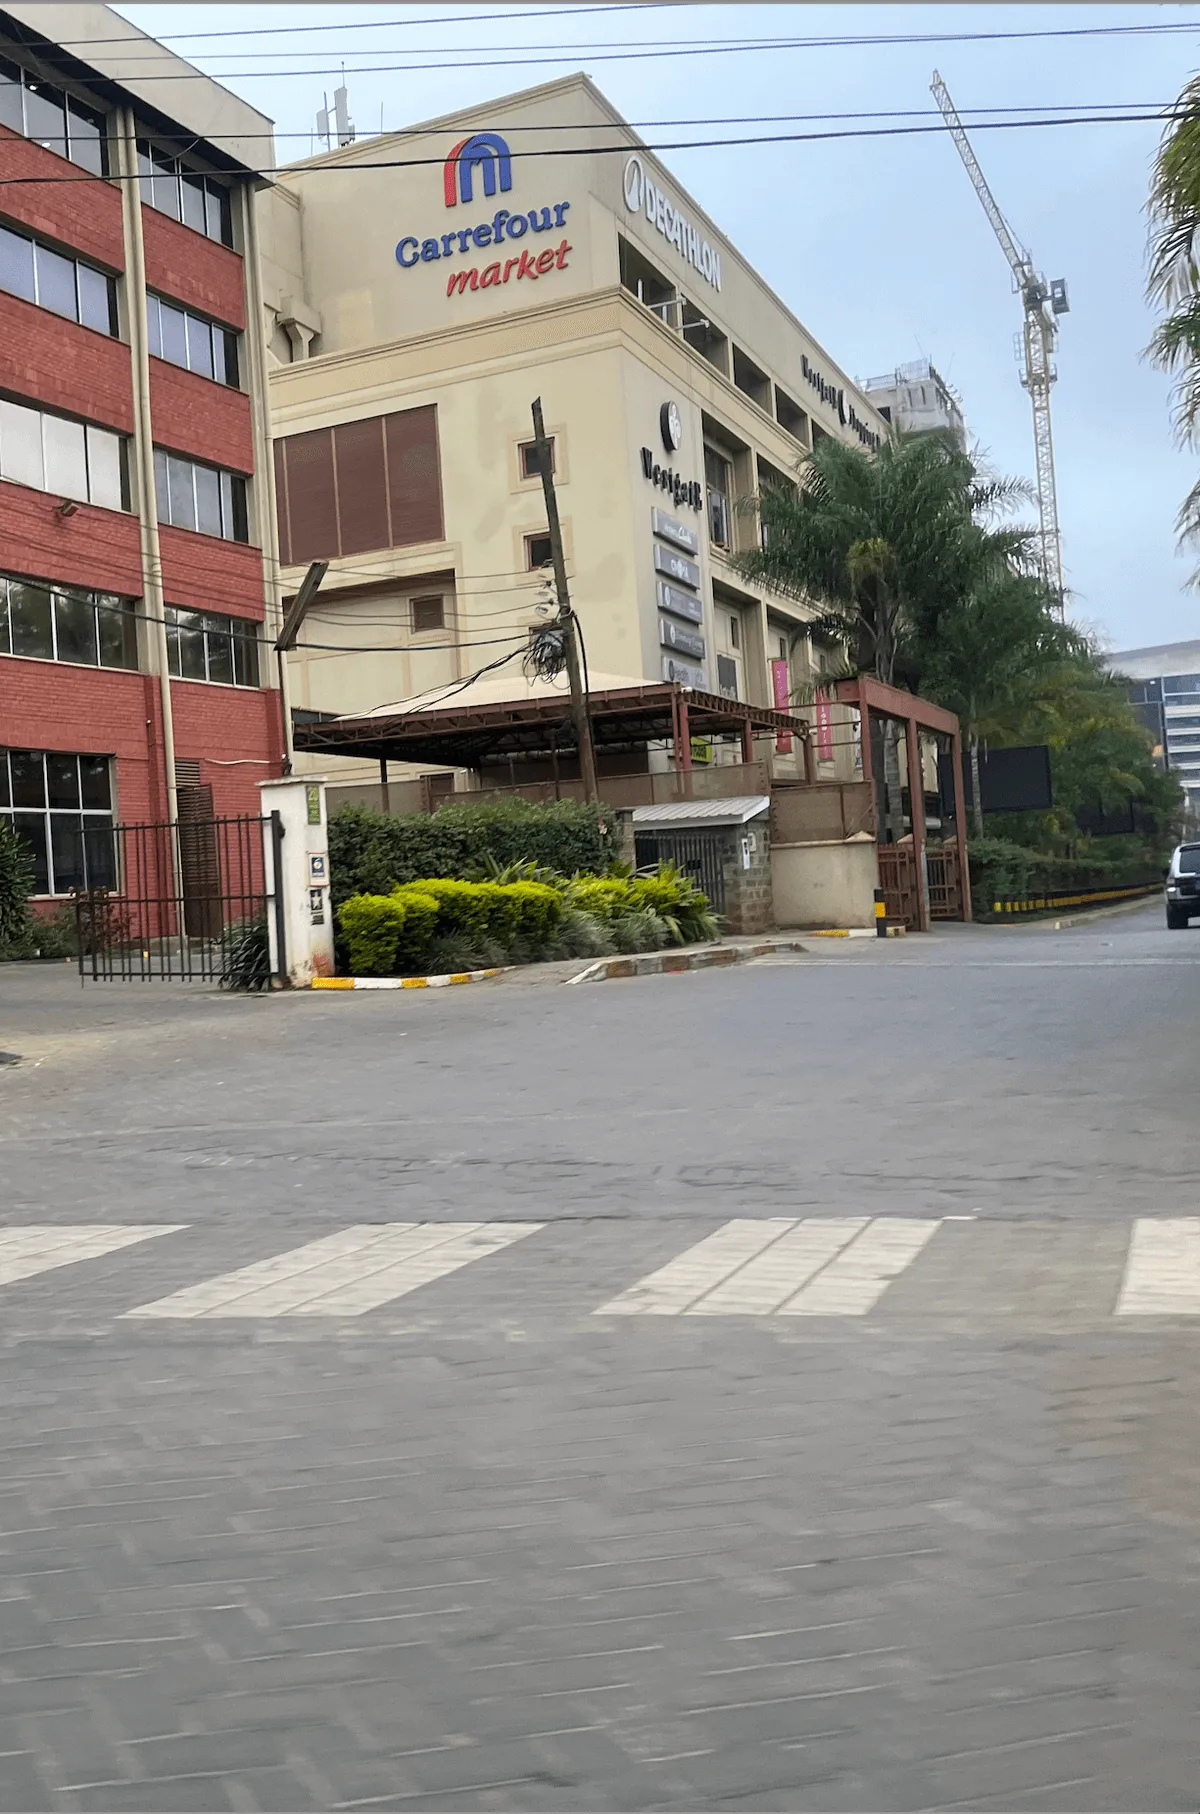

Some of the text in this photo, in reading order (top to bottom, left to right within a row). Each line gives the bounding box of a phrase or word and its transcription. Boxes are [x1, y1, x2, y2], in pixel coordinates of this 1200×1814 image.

[395, 201, 570, 268] Carrefour
[644, 175, 721, 293] DECATHLON
[446, 239, 573, 297] market
